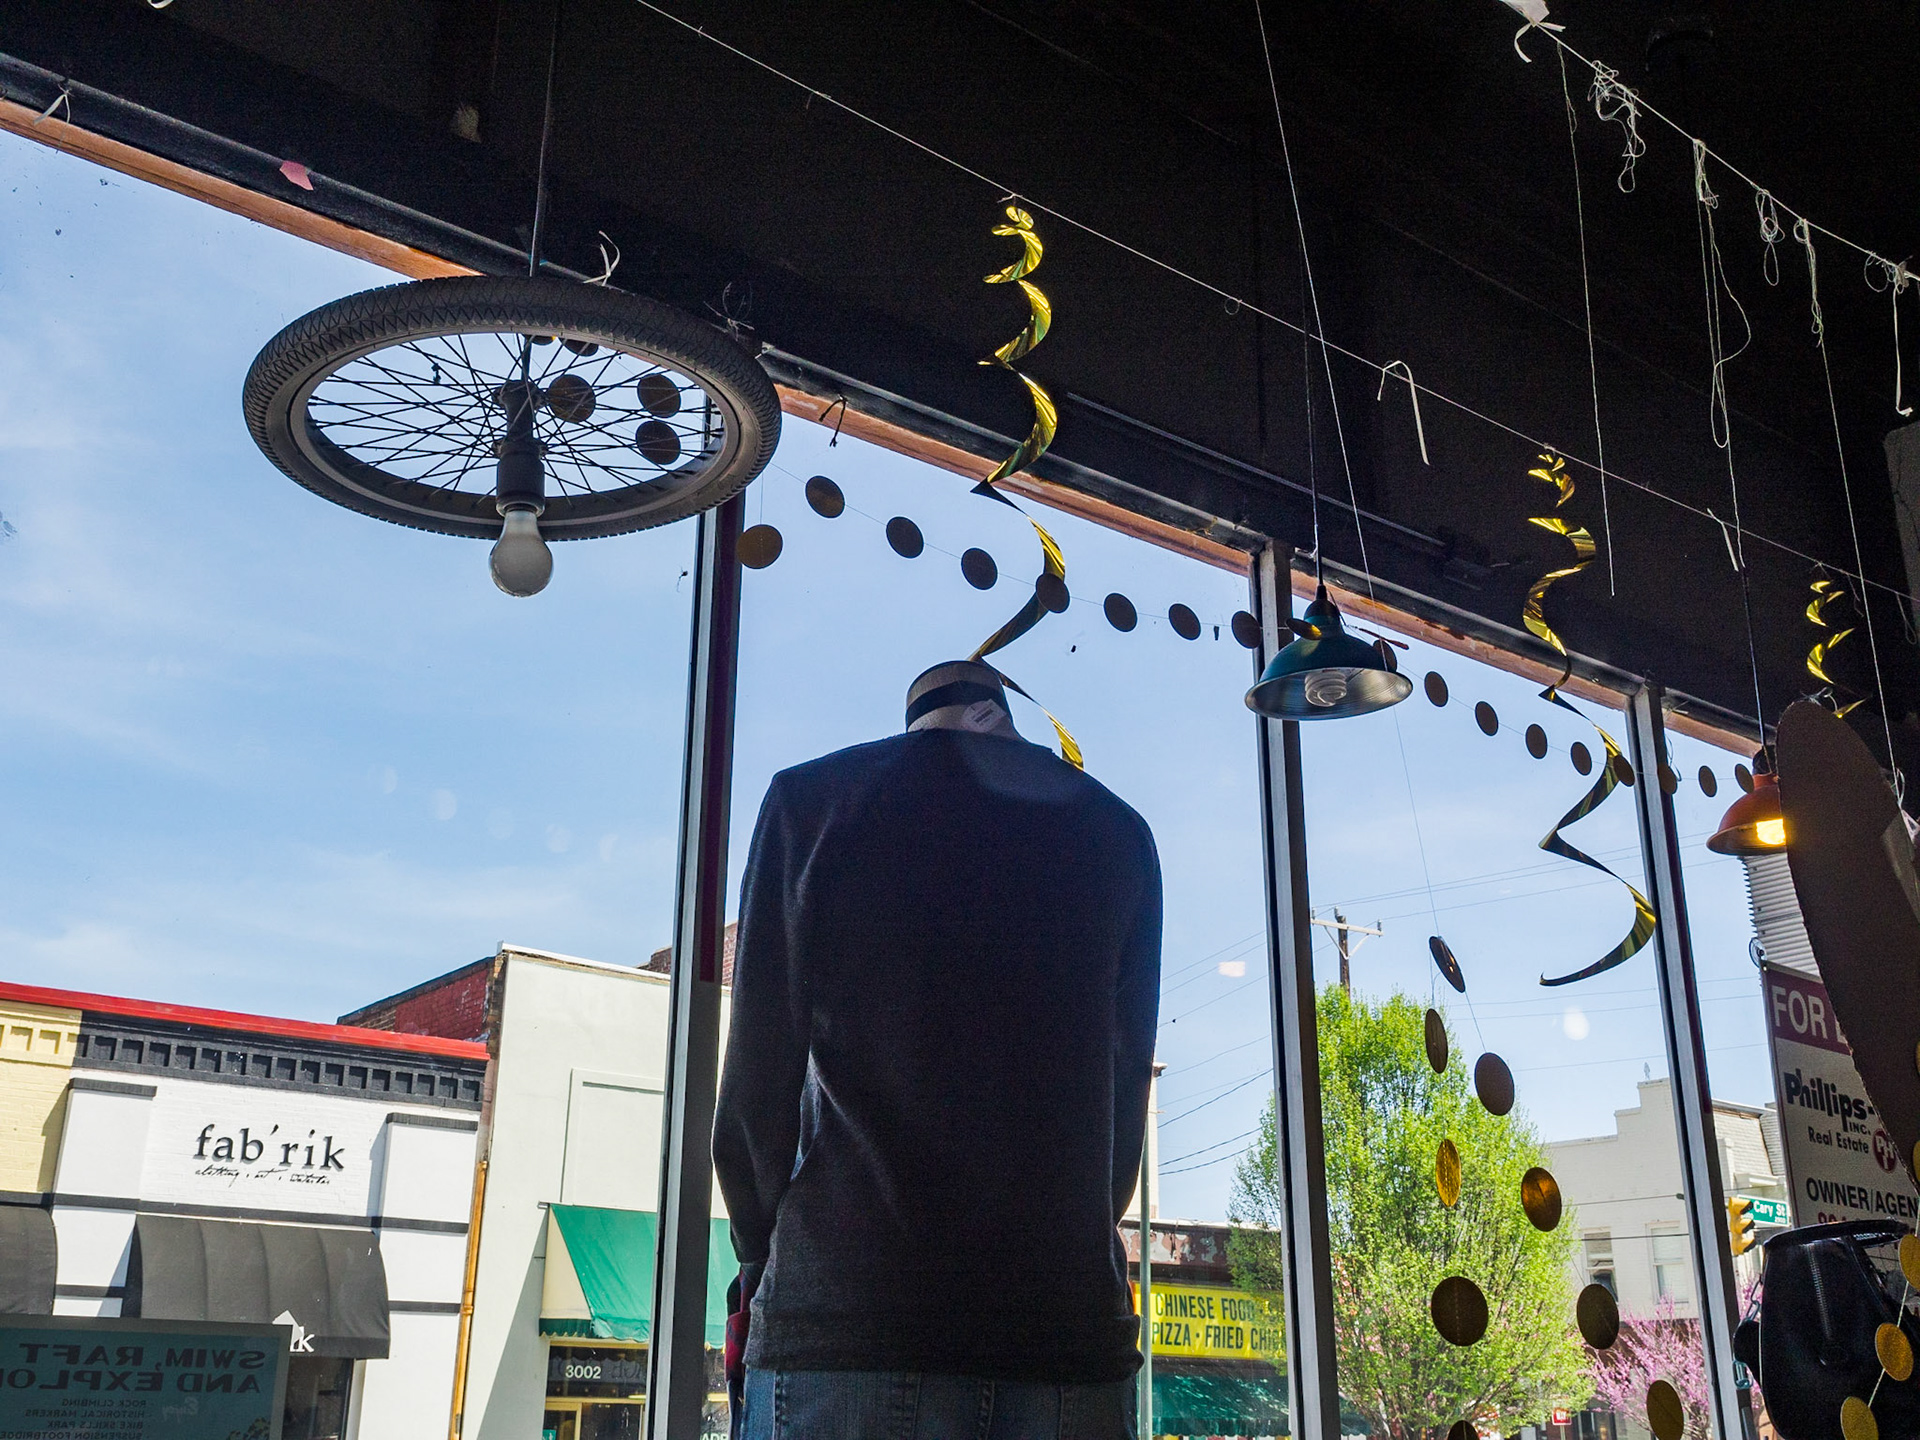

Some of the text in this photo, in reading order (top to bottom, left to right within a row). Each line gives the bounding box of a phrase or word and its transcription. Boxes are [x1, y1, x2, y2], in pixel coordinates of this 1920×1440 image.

[1772, 985, 1828, 1039] FOR
[1807, 1125, 1869, 1154] Real Estate
[1849, 1121, 1872, 1136] INC.
[193, 1123, 345, 1172] fab'rik
[1753, 1200, 1774, 1217] Cary
[1776, 1203, 1786, 1217] St
[1155, 1292, 1215, 1319] CHINESE
[1221, 1297, 1255, 1322] FOOD
[1151, 1321, 1191, 1347] PIZZA
[1205, 1325, 1244, 1350] FRIED
[565, 1364, 602, 1380] 3002
